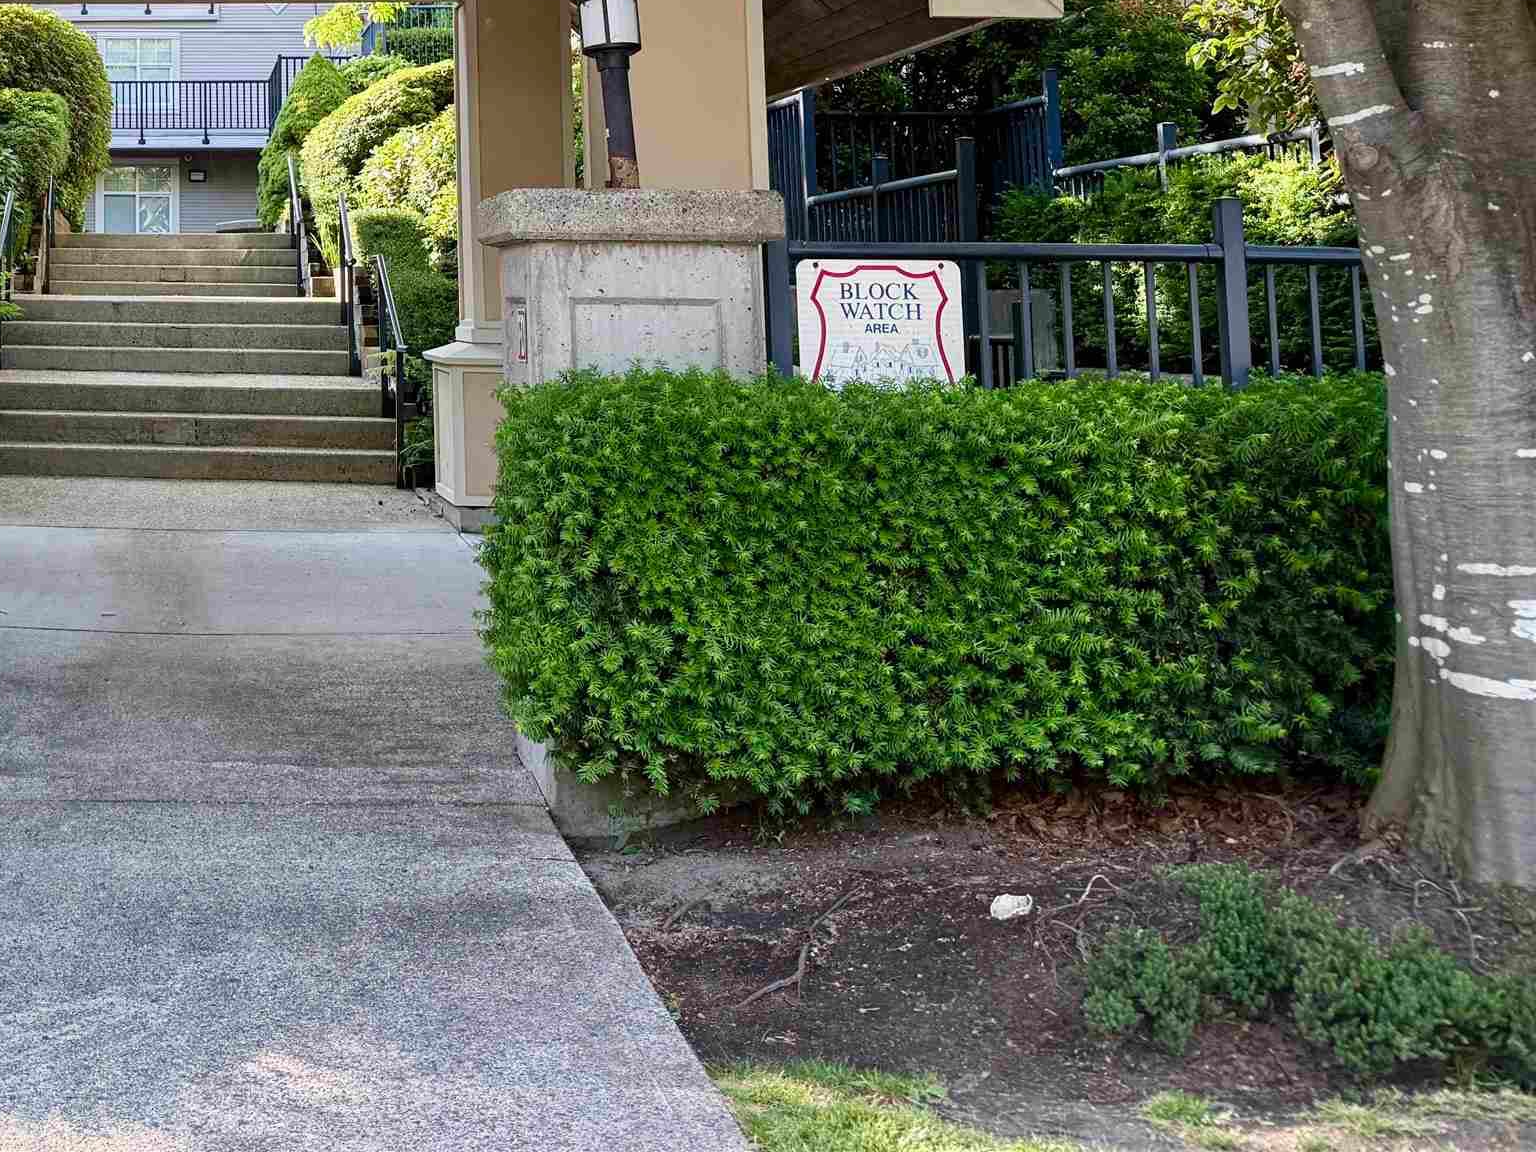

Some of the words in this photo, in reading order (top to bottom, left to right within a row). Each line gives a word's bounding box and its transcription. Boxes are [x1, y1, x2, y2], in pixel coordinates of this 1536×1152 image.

[840, 282, 919, 300] BLOCK
[840, 302, 923, 320] WATCH
[864, 323, 899, 334] AREA
